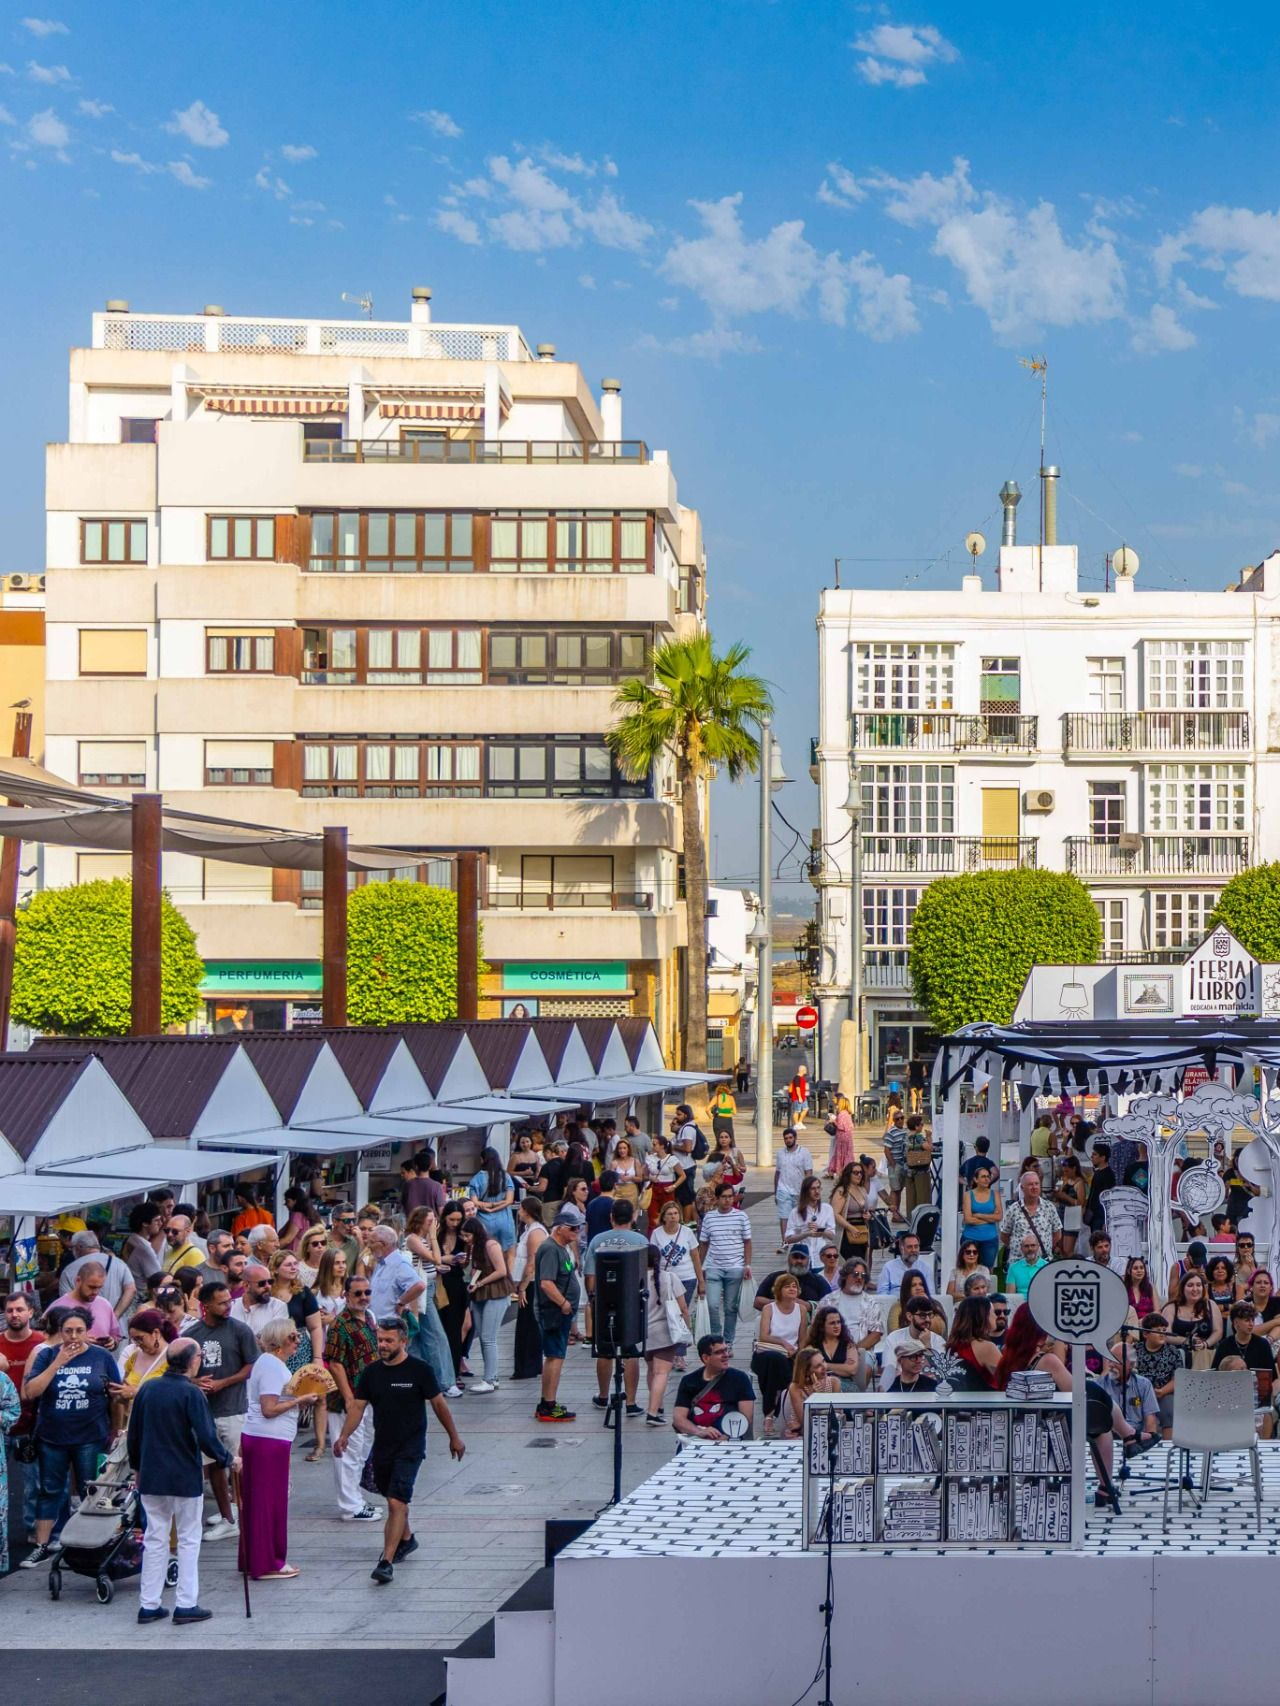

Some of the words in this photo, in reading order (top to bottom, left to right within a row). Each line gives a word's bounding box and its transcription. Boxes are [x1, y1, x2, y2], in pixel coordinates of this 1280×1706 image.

[219, 968, 304, 980] PERFUMERÍA
[530, 968, 601, 980] COSMÉTICA
[1218, 1002, 1255, 1011] mafalda
[1060, 1288, 1094, 1302] SAN
